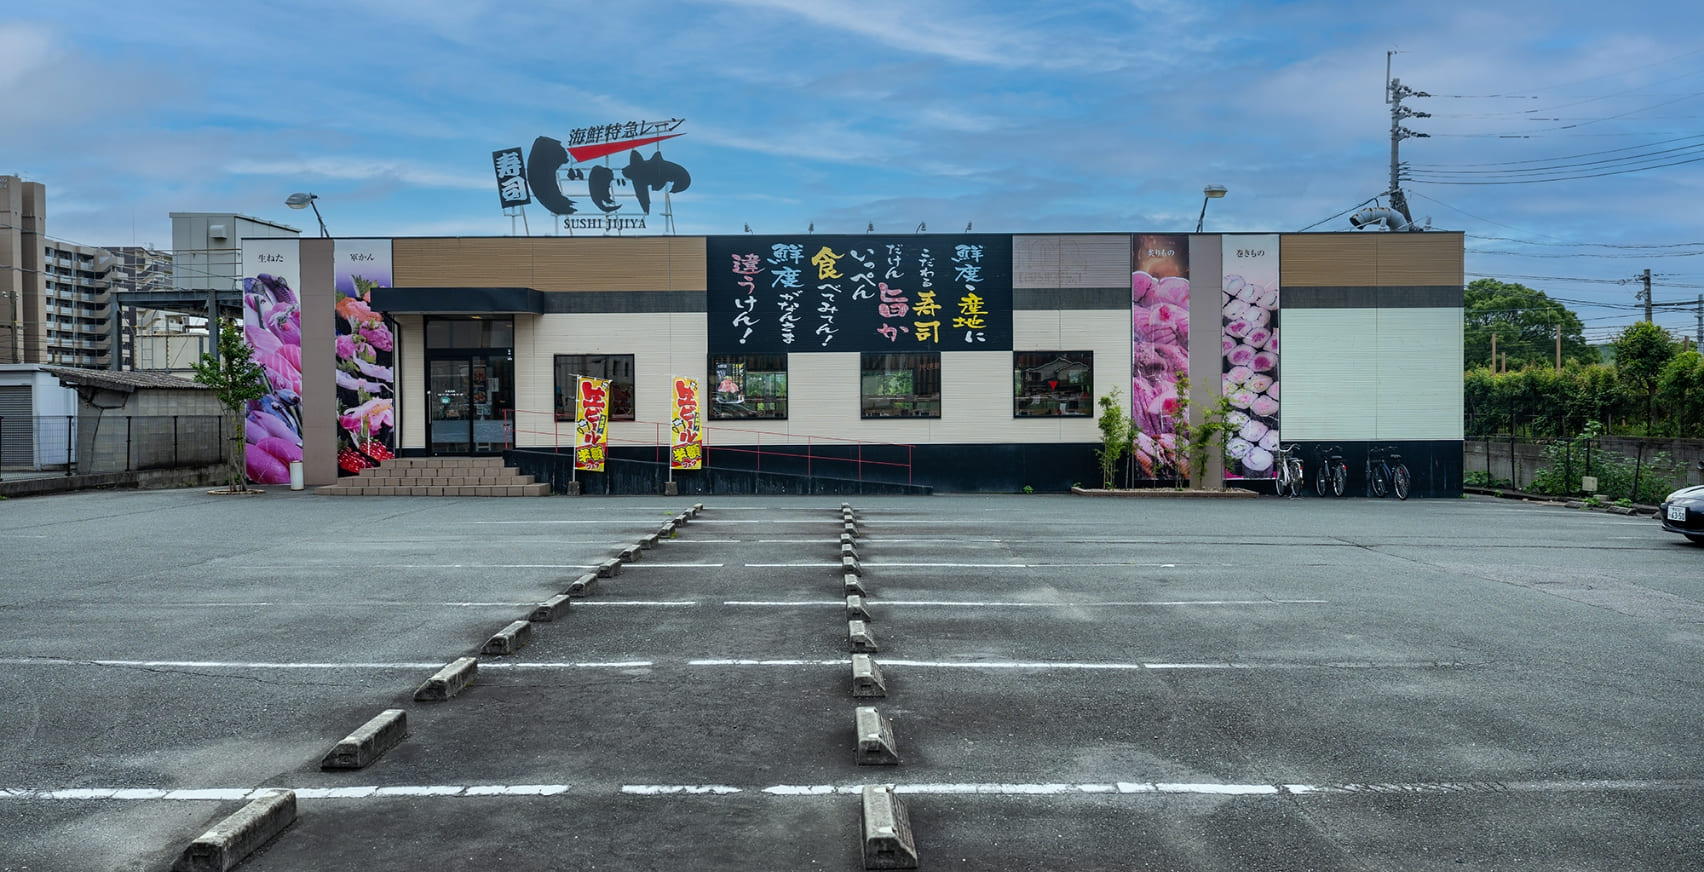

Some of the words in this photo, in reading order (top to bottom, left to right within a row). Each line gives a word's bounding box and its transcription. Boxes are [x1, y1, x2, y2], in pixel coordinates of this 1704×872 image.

[567, 118, 686, 146] 海鮮特急レーン
[495, 151, 528, 202] 寿司
[563, 217, 601, 230] SUSHI
[605, 217, 647, 231] JIJIYA
[257, 253, 284, 263] 生ねた
[849, 248, 877, 300] いっぺん
[1235, 248, 1265, 258] 巻きもの
[731, 253, 766, 344] 違うけん!
[811, 246, 845, 347] 食べてみてん!
[877, 244, 910, 342] だけん旨か
[912, 248, 942, 343] こだわる寿司
[581, 381, 605, 445] 生ビール
[675, 380, 698, 443] 生ビール
